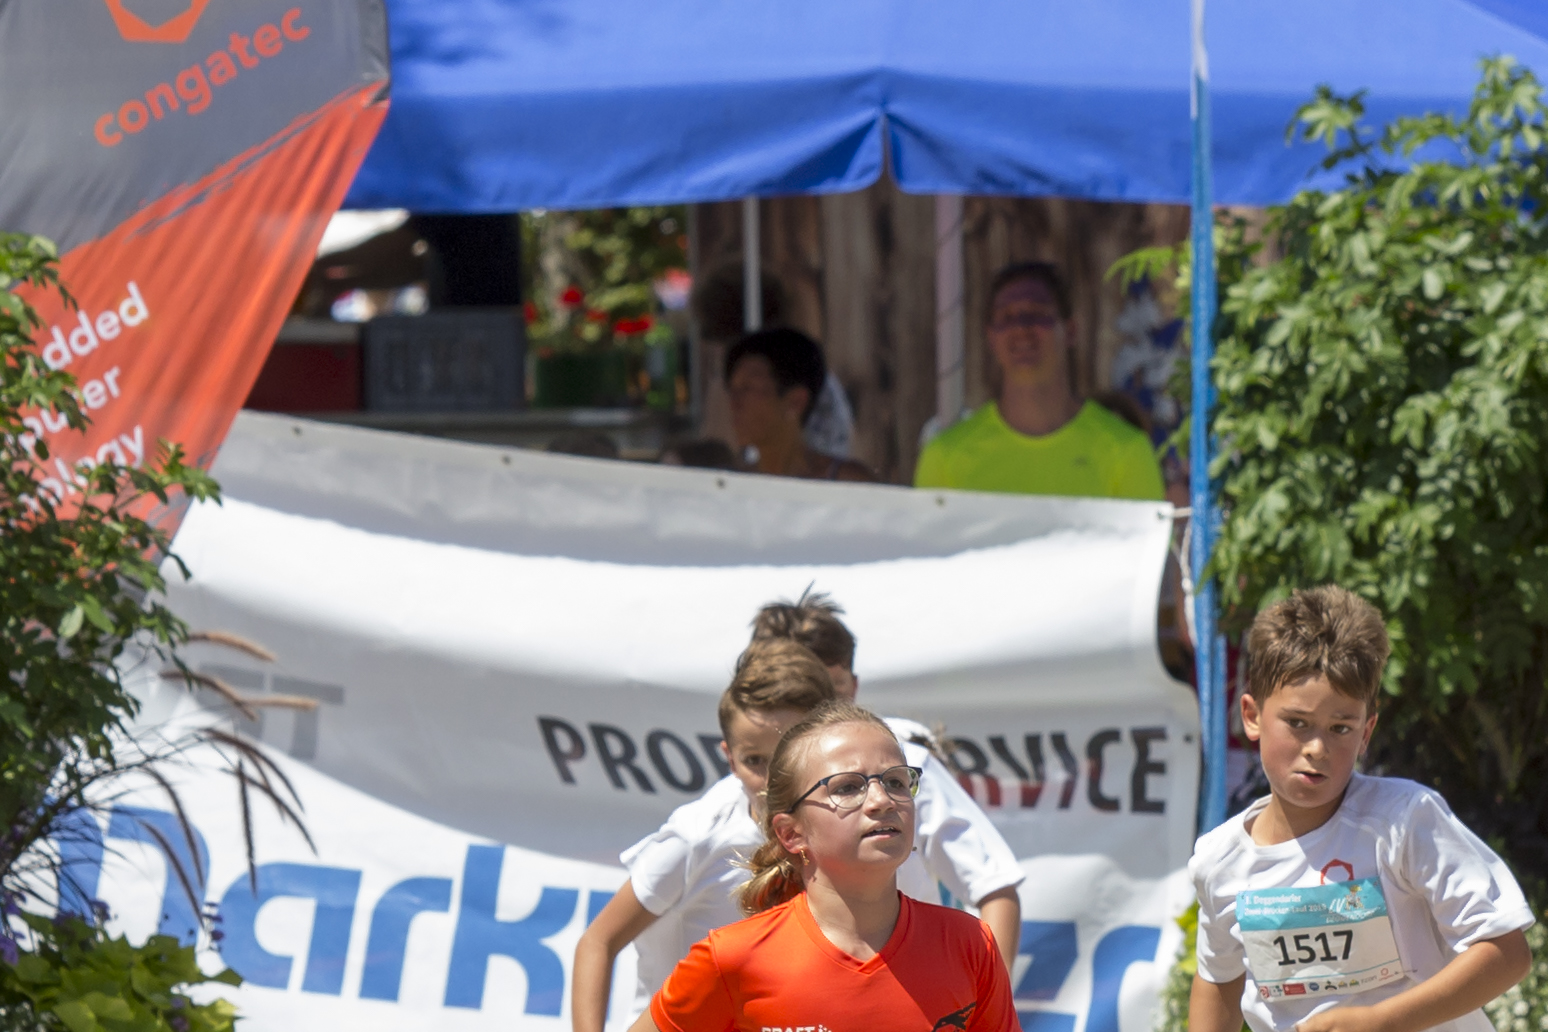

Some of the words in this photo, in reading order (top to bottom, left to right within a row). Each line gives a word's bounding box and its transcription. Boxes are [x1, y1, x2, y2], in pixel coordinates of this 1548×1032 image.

[93, 8, 311, 147] congatec
[42, 281, 149, 371] dded
[1273, 929, 1354, 967] 1517
